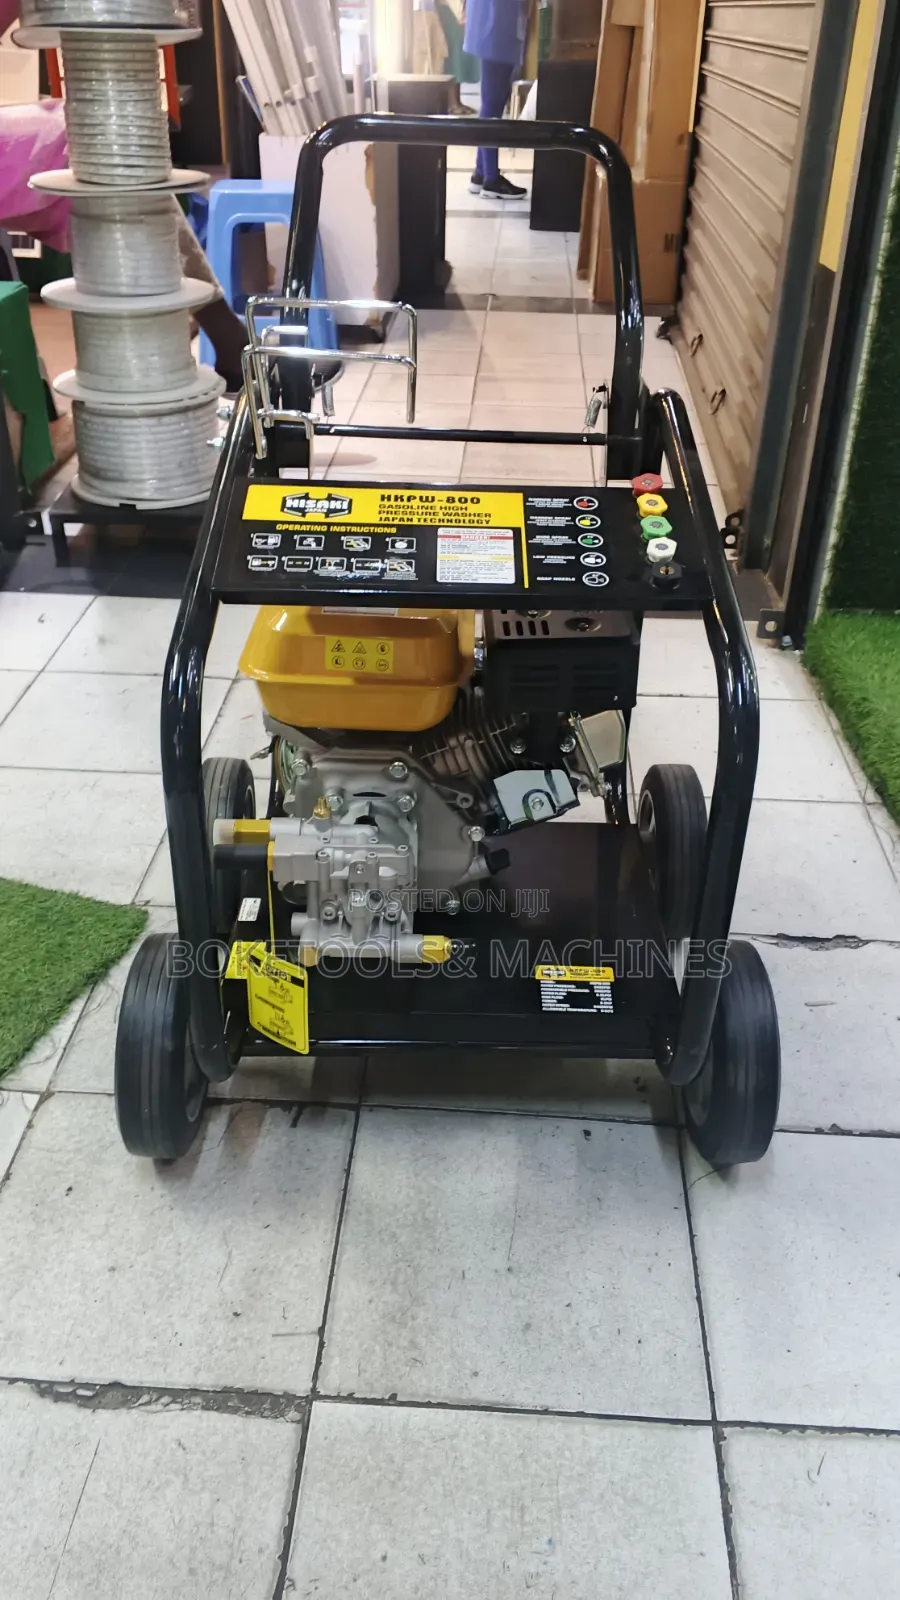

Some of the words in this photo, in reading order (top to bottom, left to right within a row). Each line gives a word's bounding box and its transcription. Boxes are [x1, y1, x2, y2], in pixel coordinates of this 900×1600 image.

[286, 499, 348, 509] HISAKI
[380, 495, 480, 504] HKPW-800
[330, 525, 396, 533] INSTRUCTIONS
